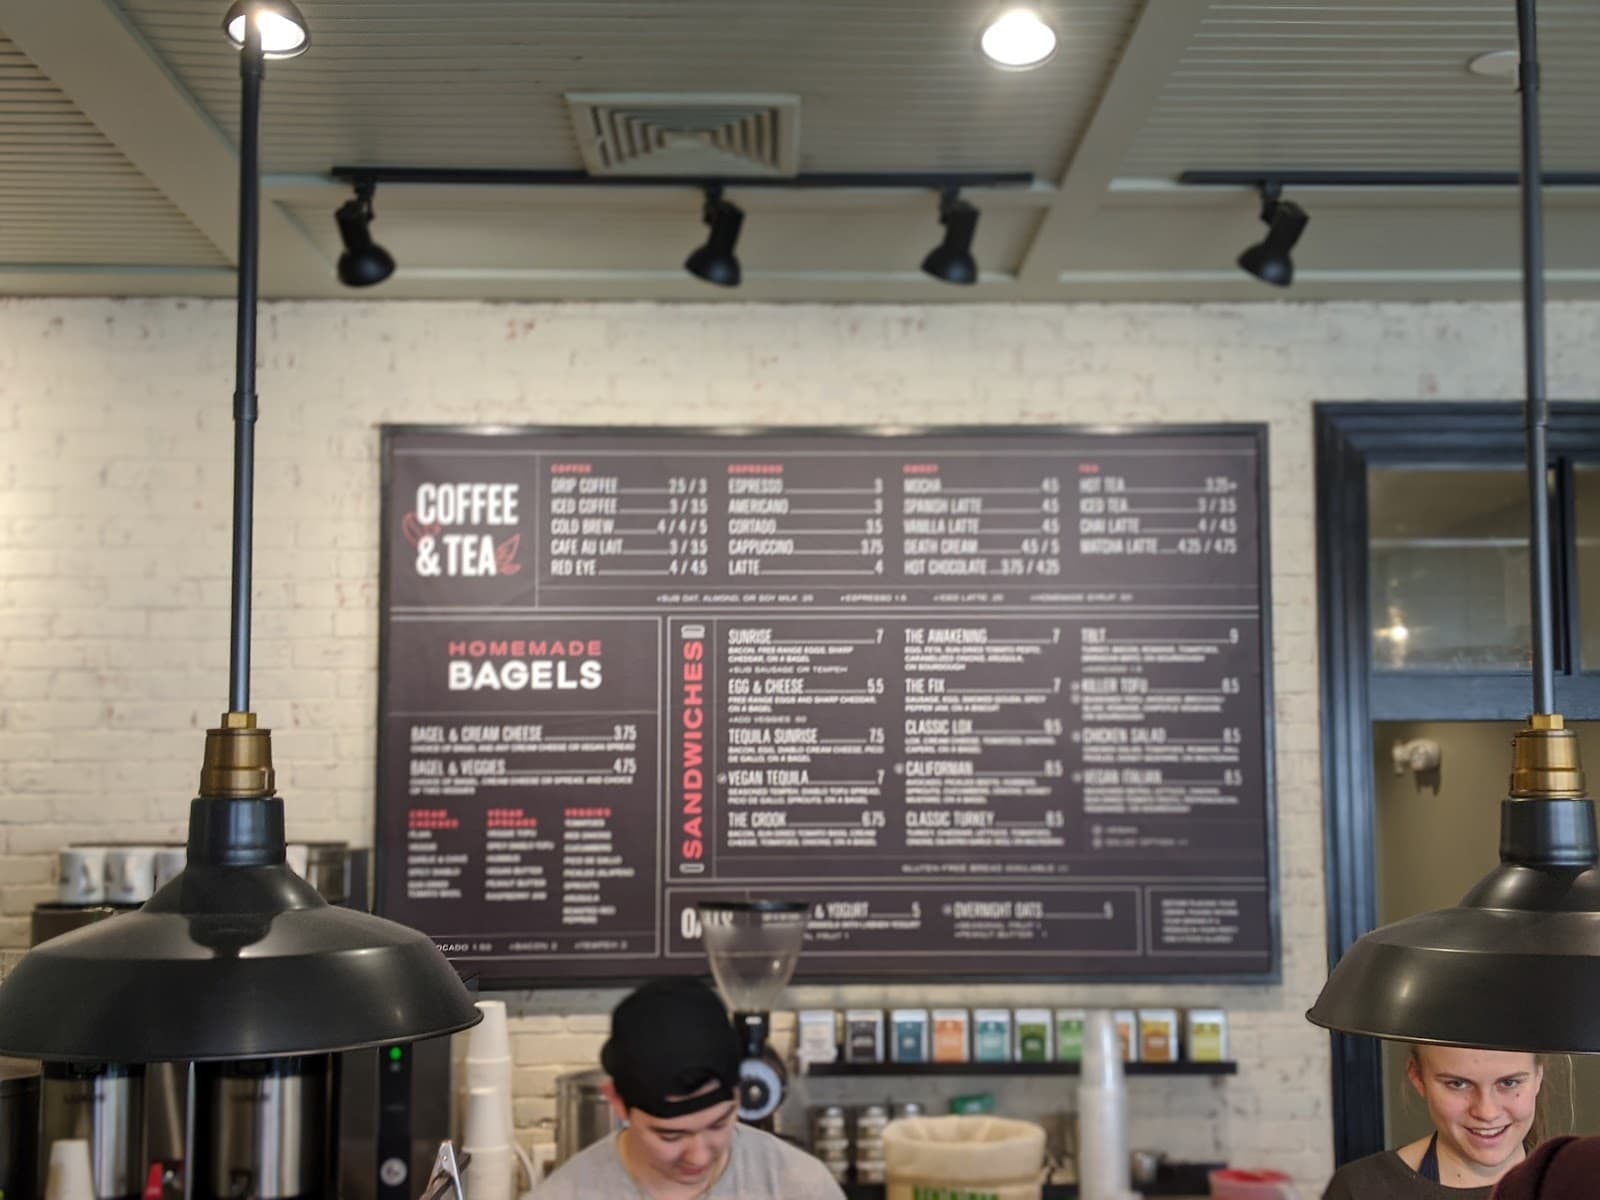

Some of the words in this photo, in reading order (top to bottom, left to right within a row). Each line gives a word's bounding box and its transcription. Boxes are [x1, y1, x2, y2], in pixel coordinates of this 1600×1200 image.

[578, 477, 618, 494] COFFEE
[416, 483, 519, 525] COFFEE
[578, 498, 618, 515] COFFEE
[728, 498, 789, 514] AMERICANO
[951, 498, 982, 514] LATTE
[550, 518, 579, 535] COLD
[582, 518, 614, 535] BREW
[728, 518, 777, 535] CORTADO
[904, 518, 945, 534] VANILLA
[948, 518, 980, 534] LATTE
[1108, 518, 1140, 534] LATTE
[580, 538, 597, 555] AU
[600, 538, 623, 555] LAIT
[728, 538, 794, 555] CAPPUCCINO
[1126, 538, 1158, 554] LATTE
[416, 535, 441, 576] &
[444, 535, 497, 576] TEA
[550, 560, 573, 576] RED
[576, 560, 596, 576] EYE
[728, 559, 760, 575] LATTE
[904, 559, 925, 575] HOT
[928, 559, 987, 575] CHOCOLATE
[728, 628, 773, 645] SUNRISE
[905, 628, 925, 644] THE
[448, 640, 602, 657] HOMEMADE
[448, 661, 602, 690] BAGELS
[728, 678, 750, 694] EGG
[765, 678, 804, 694] CHEESE
[905, 678, 925, 694] THE
[928, 678, 946, 694] FIX
[410, 725, 445, 742] BAGEL
[461, 725, 500, 742] CREAM
[502, 725, 543, 742] CHEESE
[905, 718, 950, 735] CLASSIC
[728, 728, 771, 744] TEQUILA
[774, 728, 818, 744] SUNRISE
[683, 642, 704, 859] SANDWICHES
[410, 759, 445, 776] BAGEL
[461, 759, 506, 776] VEGGIES
[728, 770, 763, 785] VEGAN
[766, 770, 809, 785] TEQUILA
[728, 812, 748, 828] THE
[906, 810, 950, 827] CLASSIC
